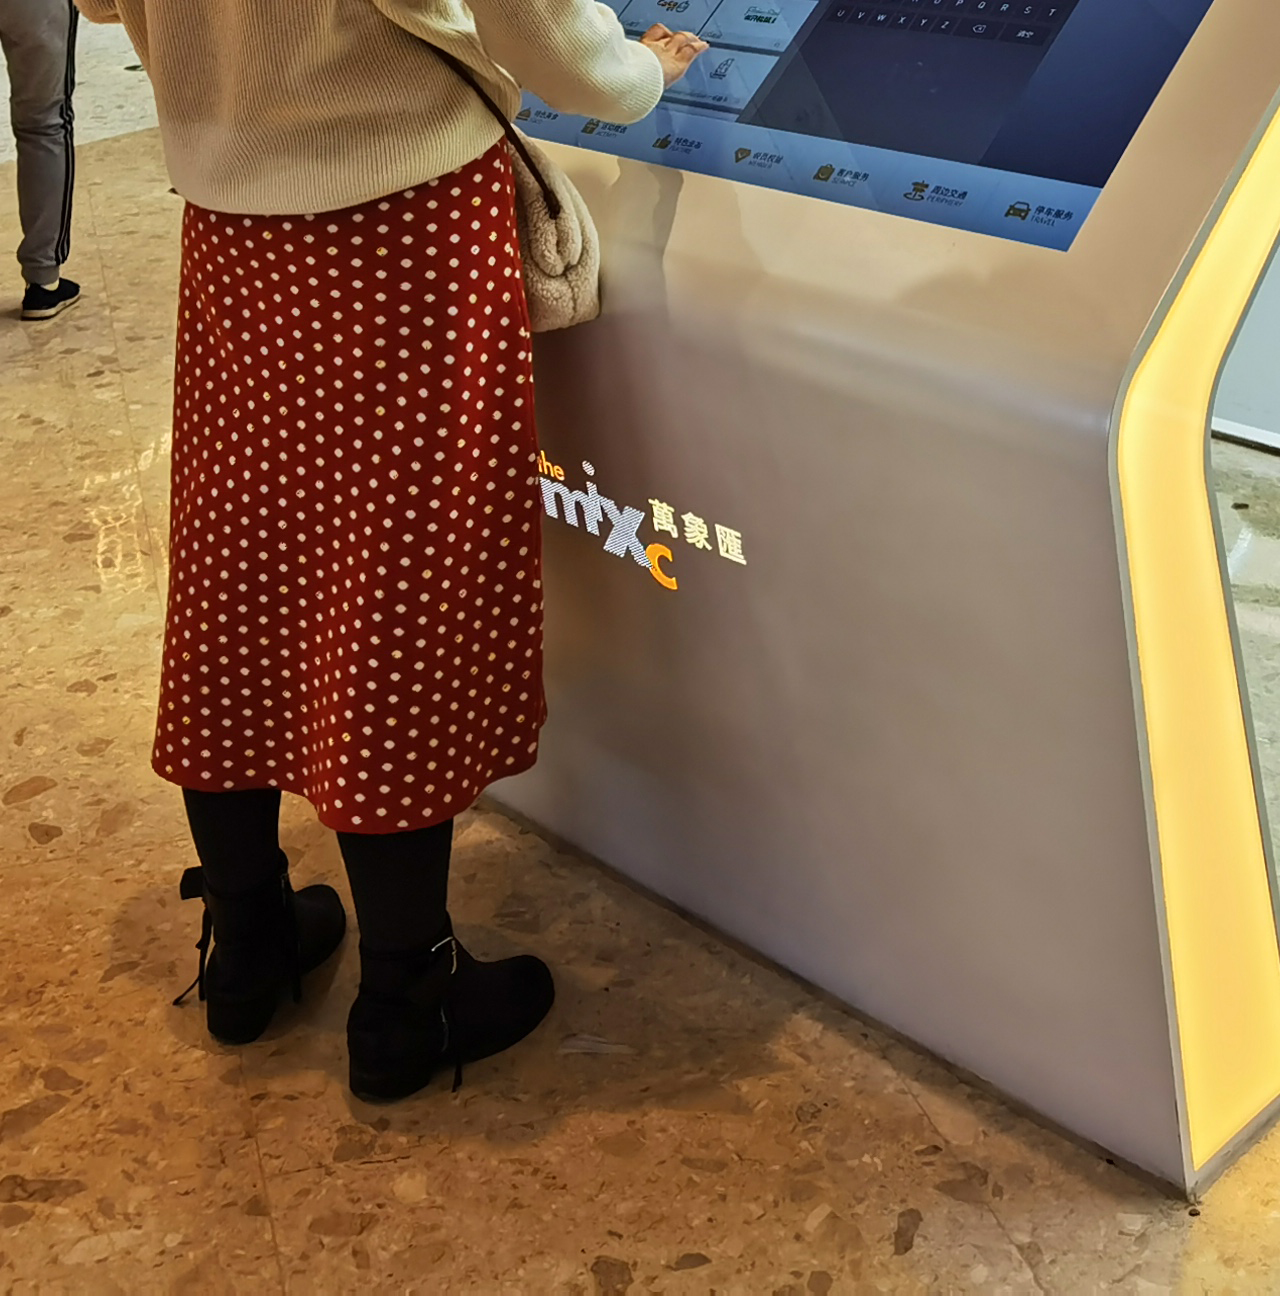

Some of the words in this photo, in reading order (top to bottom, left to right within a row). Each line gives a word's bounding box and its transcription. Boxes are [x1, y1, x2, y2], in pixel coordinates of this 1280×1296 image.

[836, 168, 870, 182] 客户服务
[930, 185, 968, 200] 周边交通
[1034, 205, 1074, 221] 停车服务
